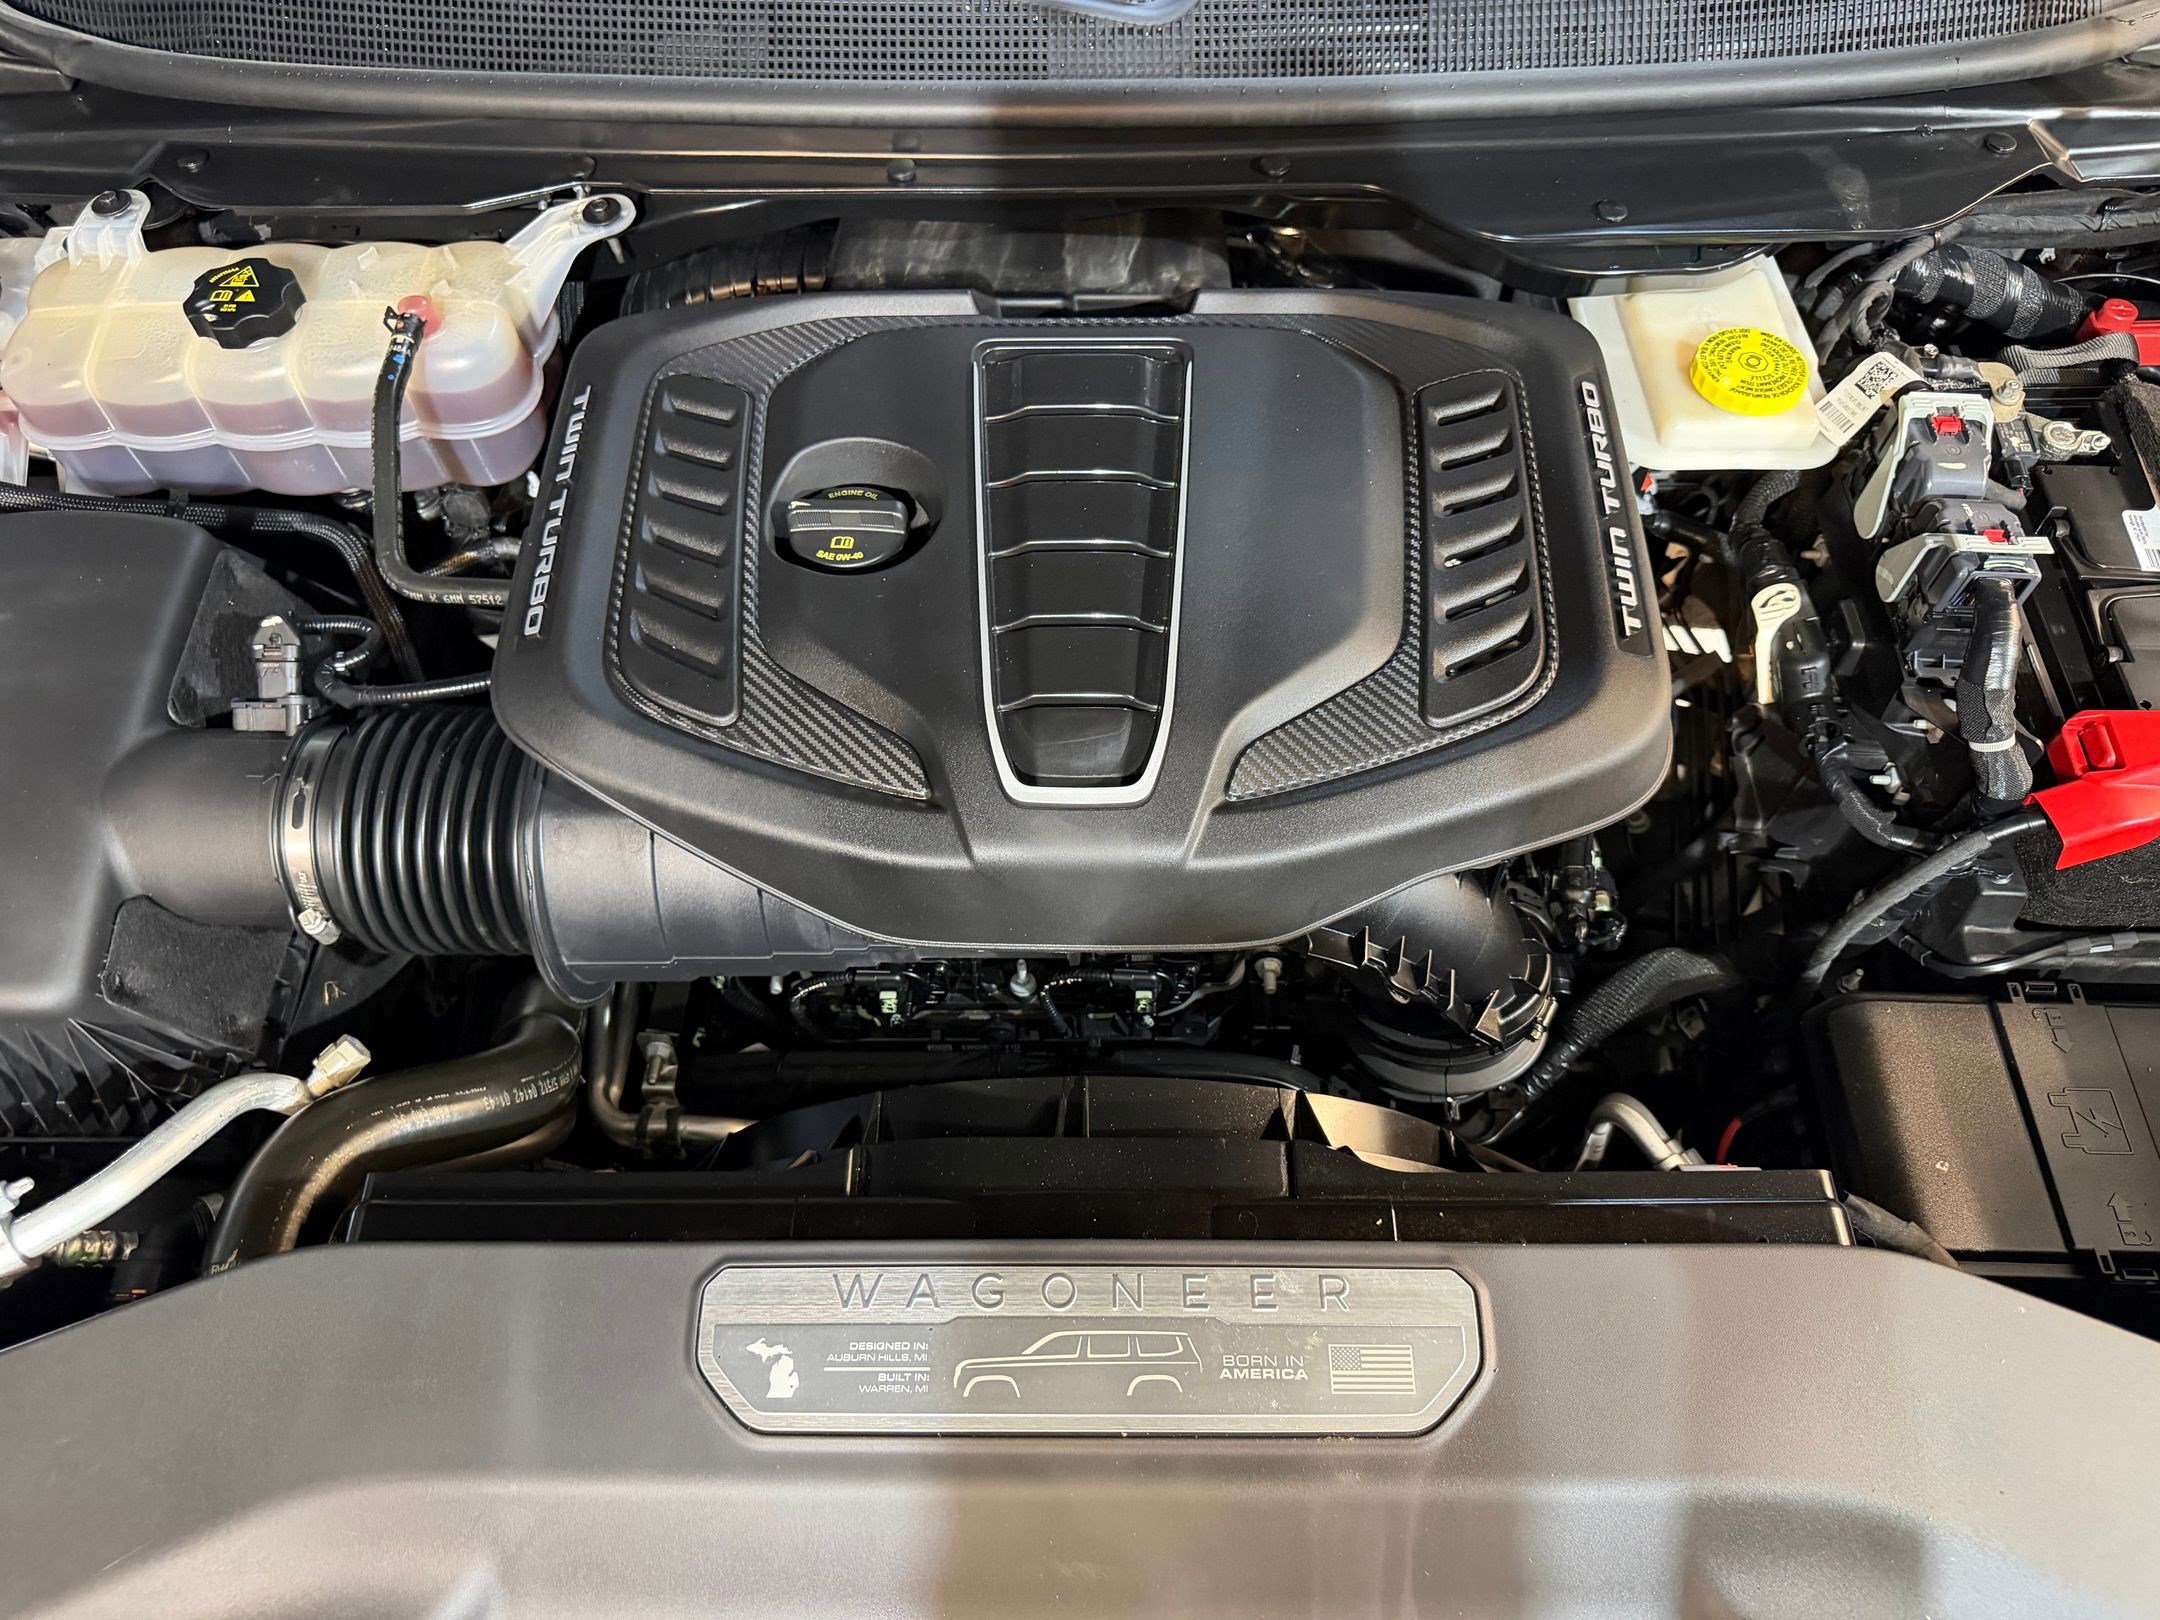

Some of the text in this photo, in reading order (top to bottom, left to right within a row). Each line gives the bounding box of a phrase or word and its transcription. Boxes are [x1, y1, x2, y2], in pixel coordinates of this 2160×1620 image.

[1705, 332, 1720, 344] FROM
[1716, 328, 1734, 337] FLUID
[1726, 333, 1749, 341] BEFORE
[1761, 335, 1782, 348] AVANT
[1781, 340, 1799, 354] GARDE
[1716, 345, 1727, 359] FILLER
[1778, 380, 1801, 397] BOUCHON
[827, 489, 879, 501] ENGINE OIL
[523, 384, 592, 637] TWIN TURBO
[1581, 381, 1642, 637] TWIN TURBO
[816, 549, 864, 562] SAE 0W-40
[468, 594, 504, 606] 57512
[832, 1272, 1351, 1312] WAGONEER
[849, 1341, 929, 1351] DESIGNED IN:
[827, 1353, 928, 1364] AUBURN HILLS, MI
[1223, 1355, 1304, 1367] BORN IN
[877, 1373, 930, 1382] BUILT IN:
[1219, 1368, 1308, 1380] AMERICA
[858, 1384, 929, 1394] WARREN, MI
